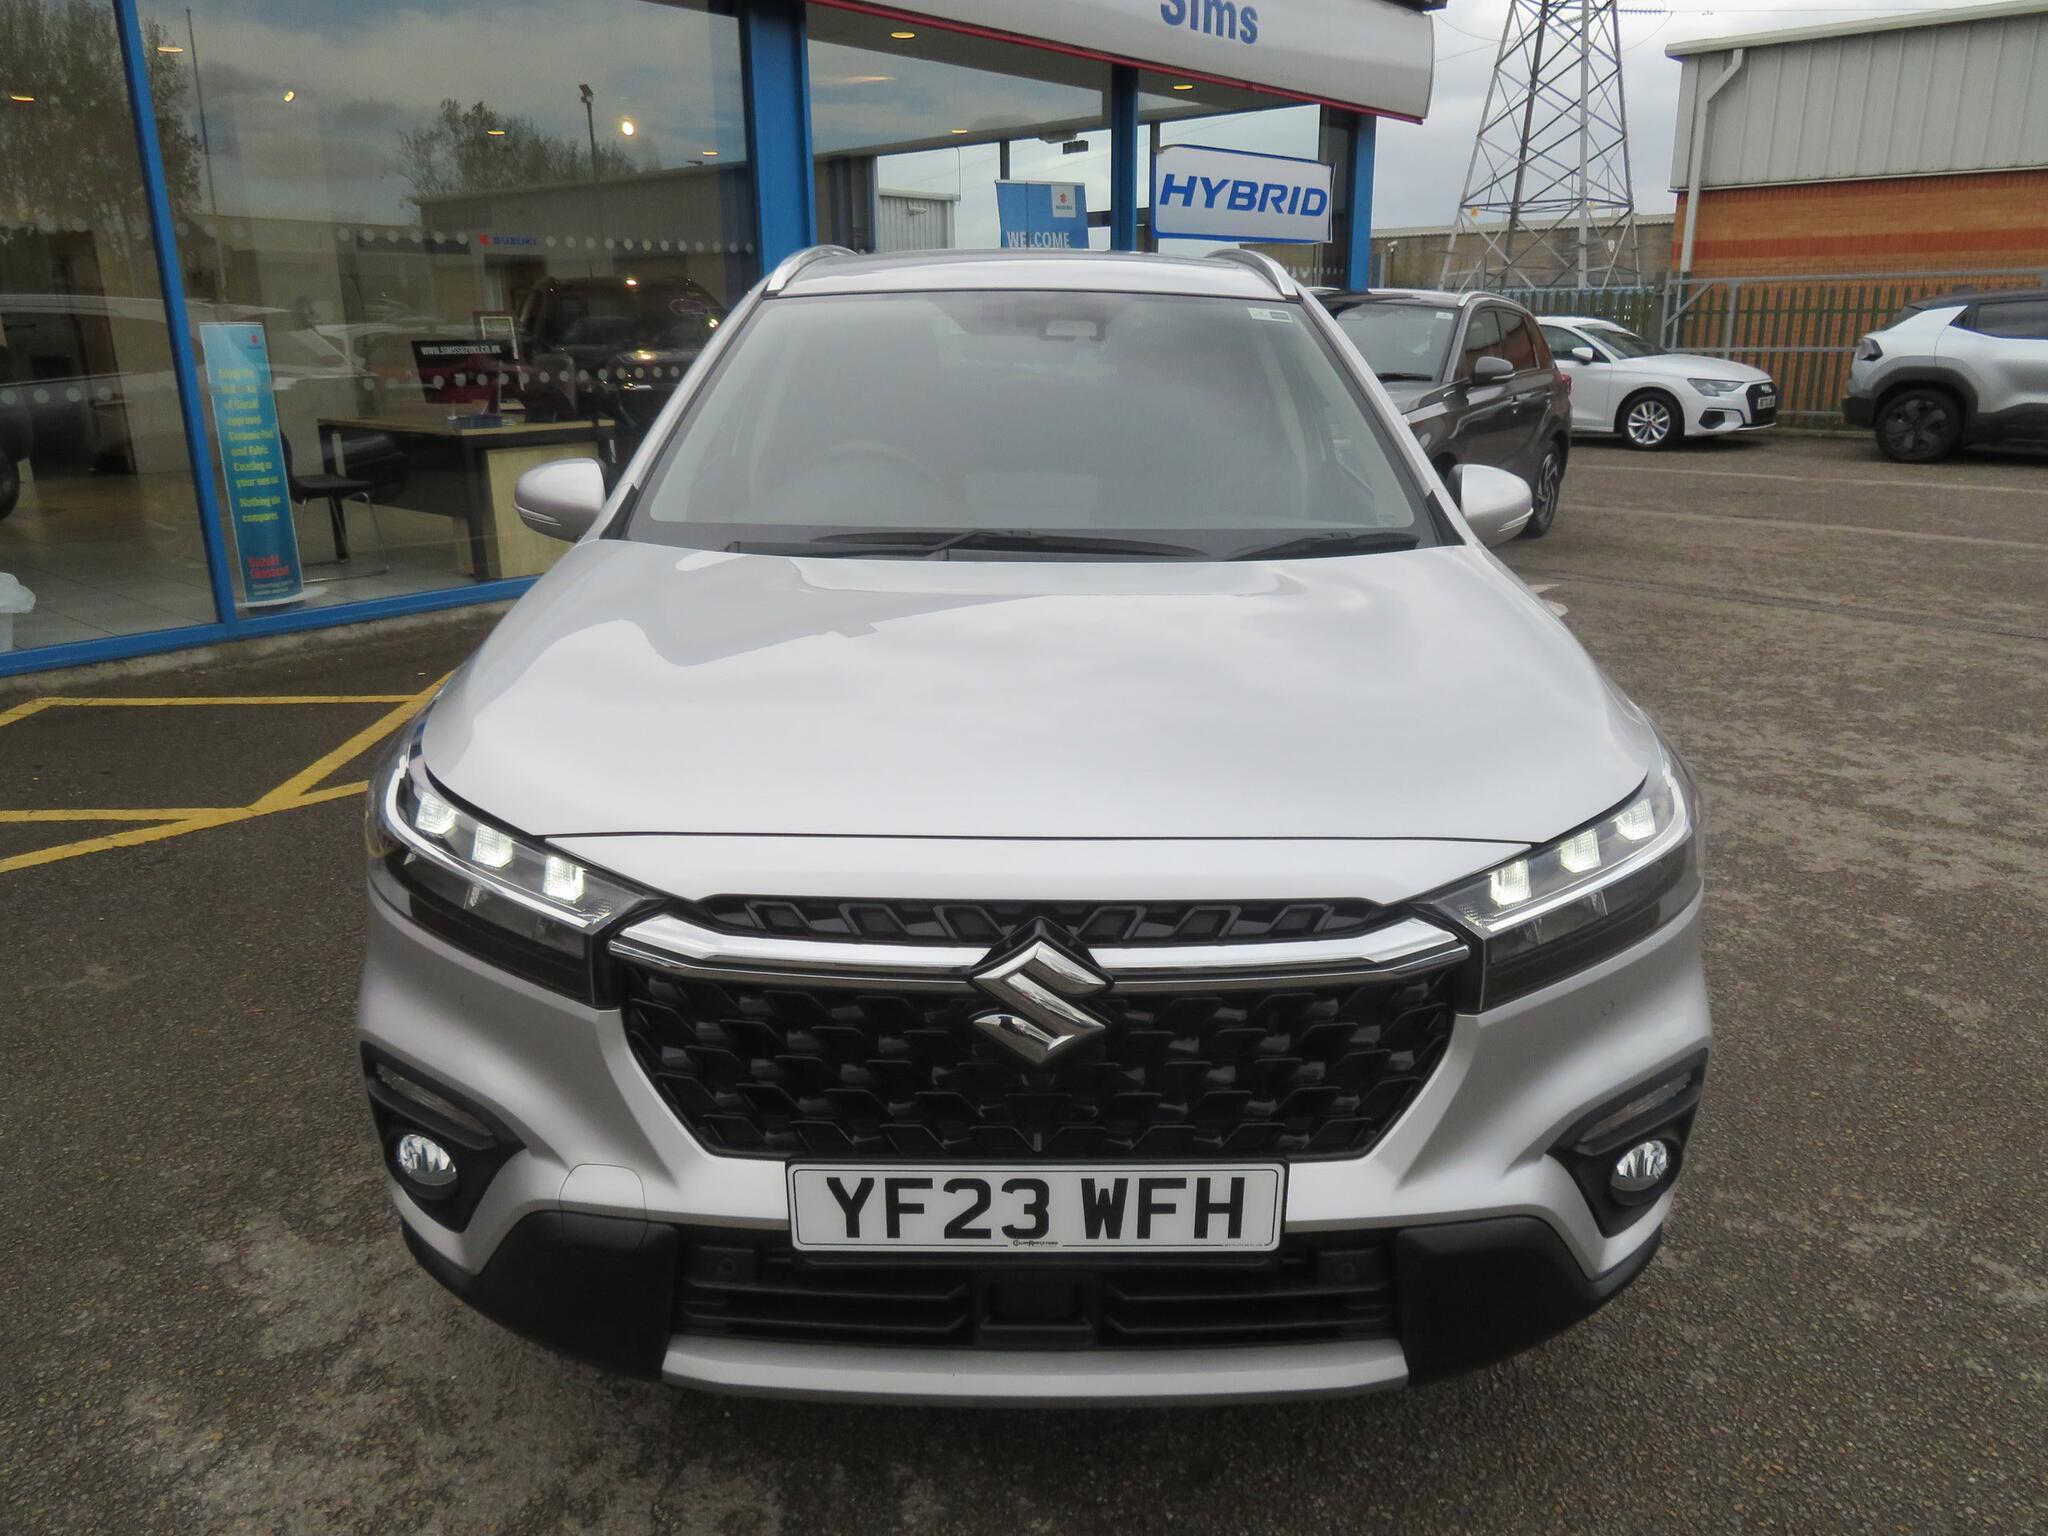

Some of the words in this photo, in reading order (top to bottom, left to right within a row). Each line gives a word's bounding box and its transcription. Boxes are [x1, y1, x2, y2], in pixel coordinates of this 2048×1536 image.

[1159, 173, 1328, 217] HYBRID
[1007, 231, 1070, 248] WELCOME
[827, 1177, 1050, 1239] YF23
[1080, 1177, 1246, 1239] WFH
